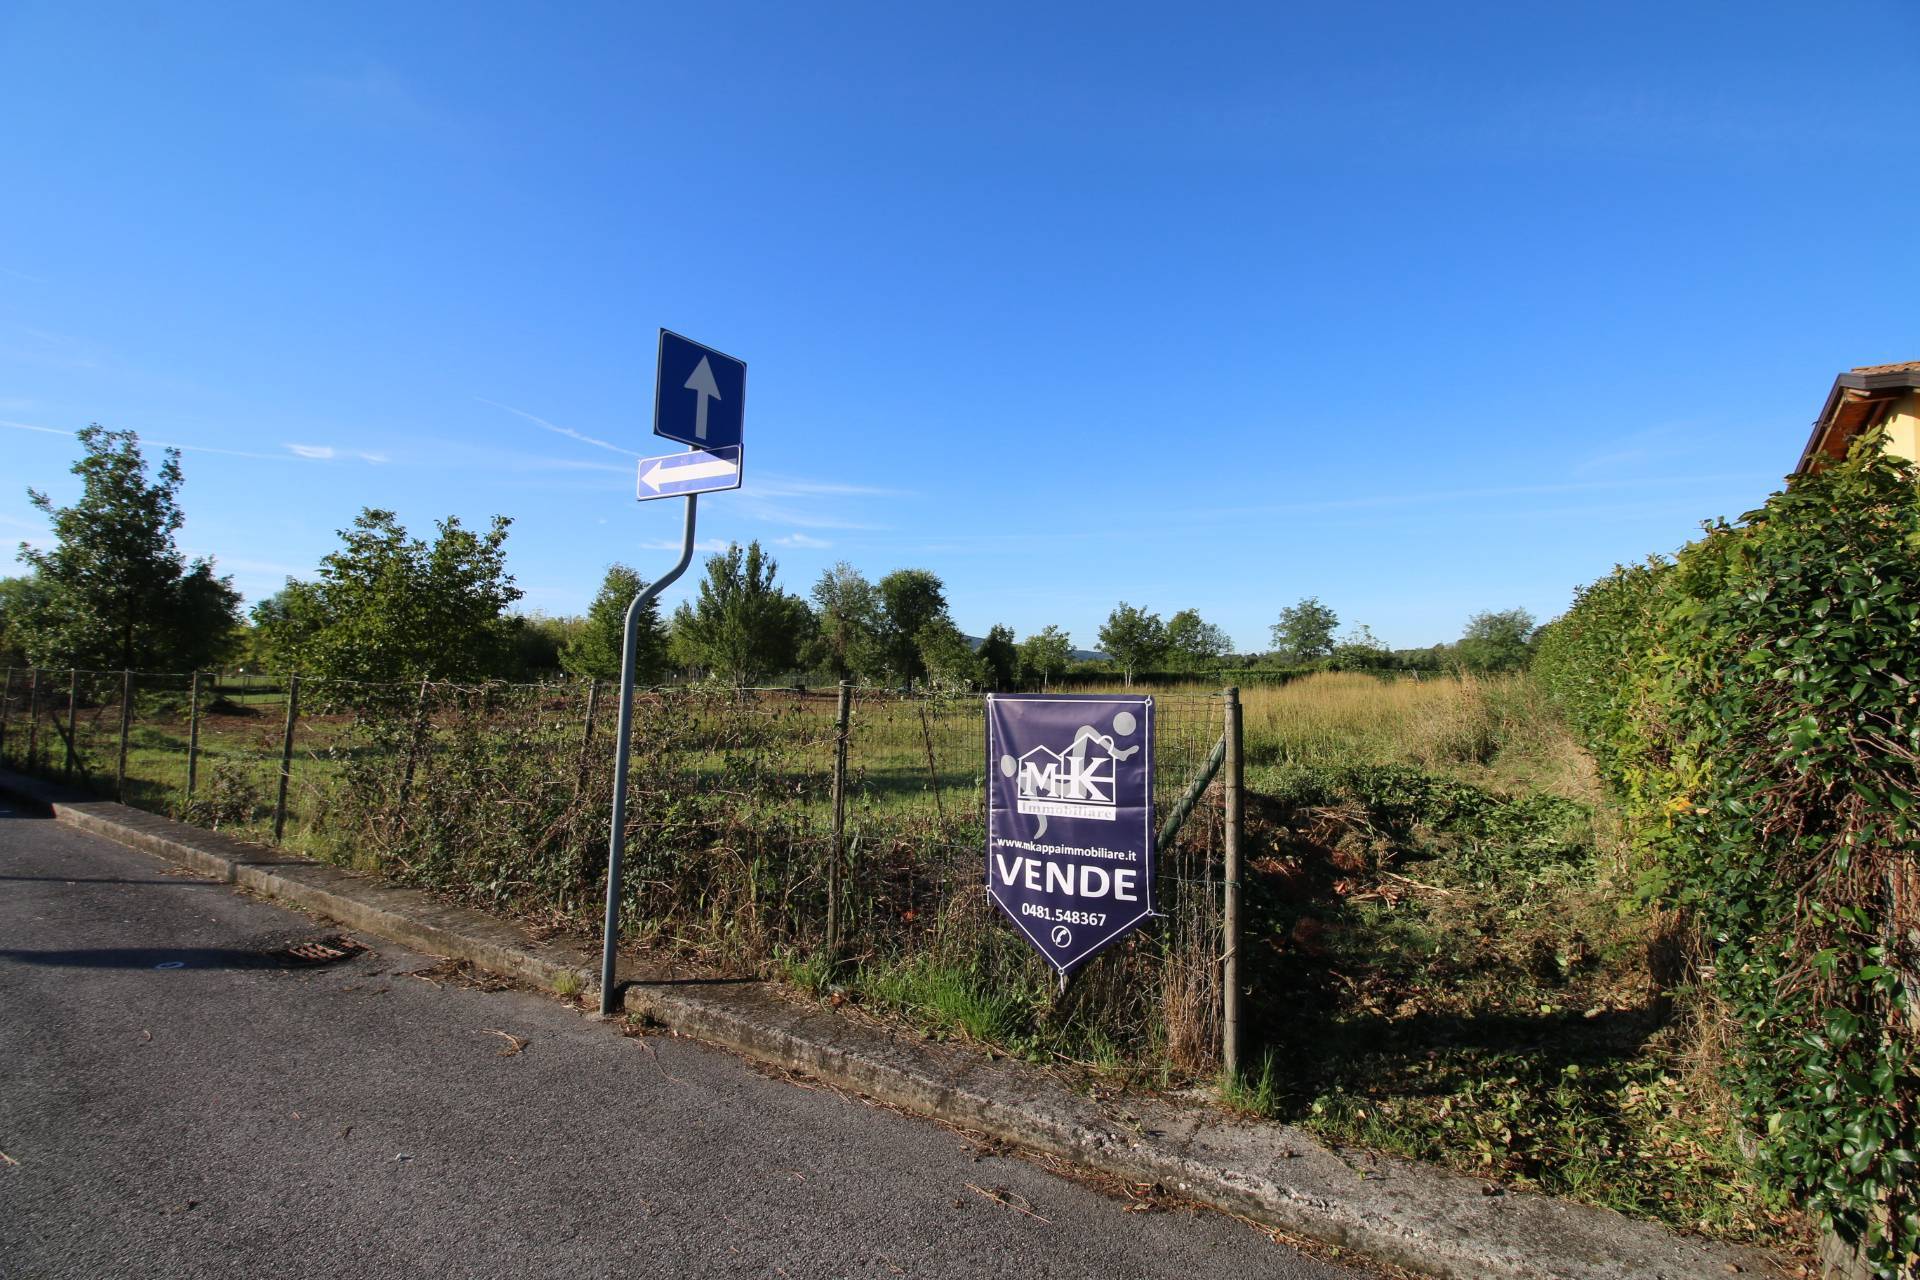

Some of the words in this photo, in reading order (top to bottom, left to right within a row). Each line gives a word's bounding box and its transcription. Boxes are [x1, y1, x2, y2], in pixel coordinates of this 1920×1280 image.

[1022, 802, 1112, 818] Immobiliare
[997, 838, 1137, 861] www.mkappaimmobiliare.it
[997, 854, 1137, 902] VENDE
[1021, 902, 1107, 926] 0481.548367
